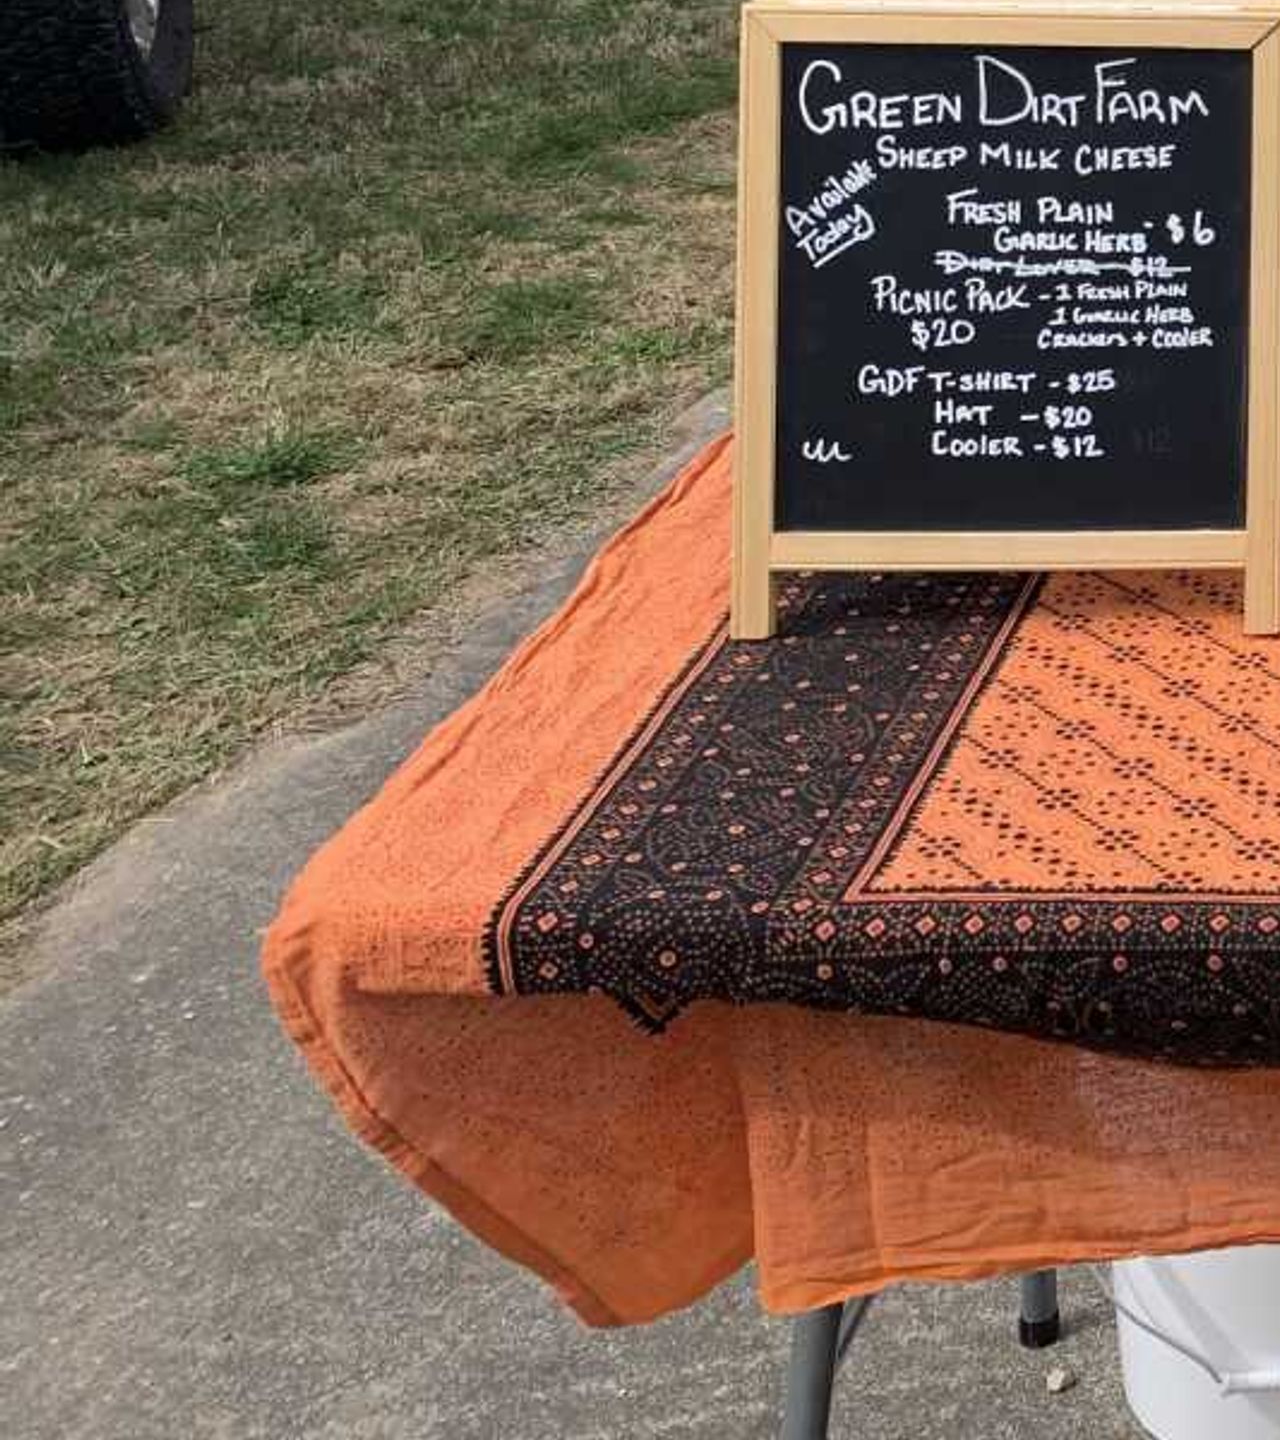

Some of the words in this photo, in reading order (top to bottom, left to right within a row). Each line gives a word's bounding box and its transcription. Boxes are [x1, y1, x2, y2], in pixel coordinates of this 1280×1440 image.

[798, 59, 962, 137] GREEN
[975, 55, 1086, 127] DIRT
[1094, 57, 1209, 125] FARM
[875, 134, 968, 170] SHEEP
[979, 142, 1061, 170] MILK
[1074, 143, 1176, 176] CHEESE
[783, 158, 878, 236] Available
[946, 187, 1021, 225] FRESH
[1036, 196, 1114, 226] PLAIN
[795, 203, 876, 260] Today
[993, 225, 1079, 254] GARLIC
[1084, 229, 1148, 254] HERB
[870, 275, 958, 315] PICNIC
[964, 276, 1031, 313] PACK
[1134, 279, 1188, 300] PLAIN
[1144, 303, 1195, 325] HERB
[910, 318, 976, 351] $20
[858, 364, 926, 397] GDF
[926, 370, 1037, 393] T-SHIRT
[935, 398, 993, 426] HAT
